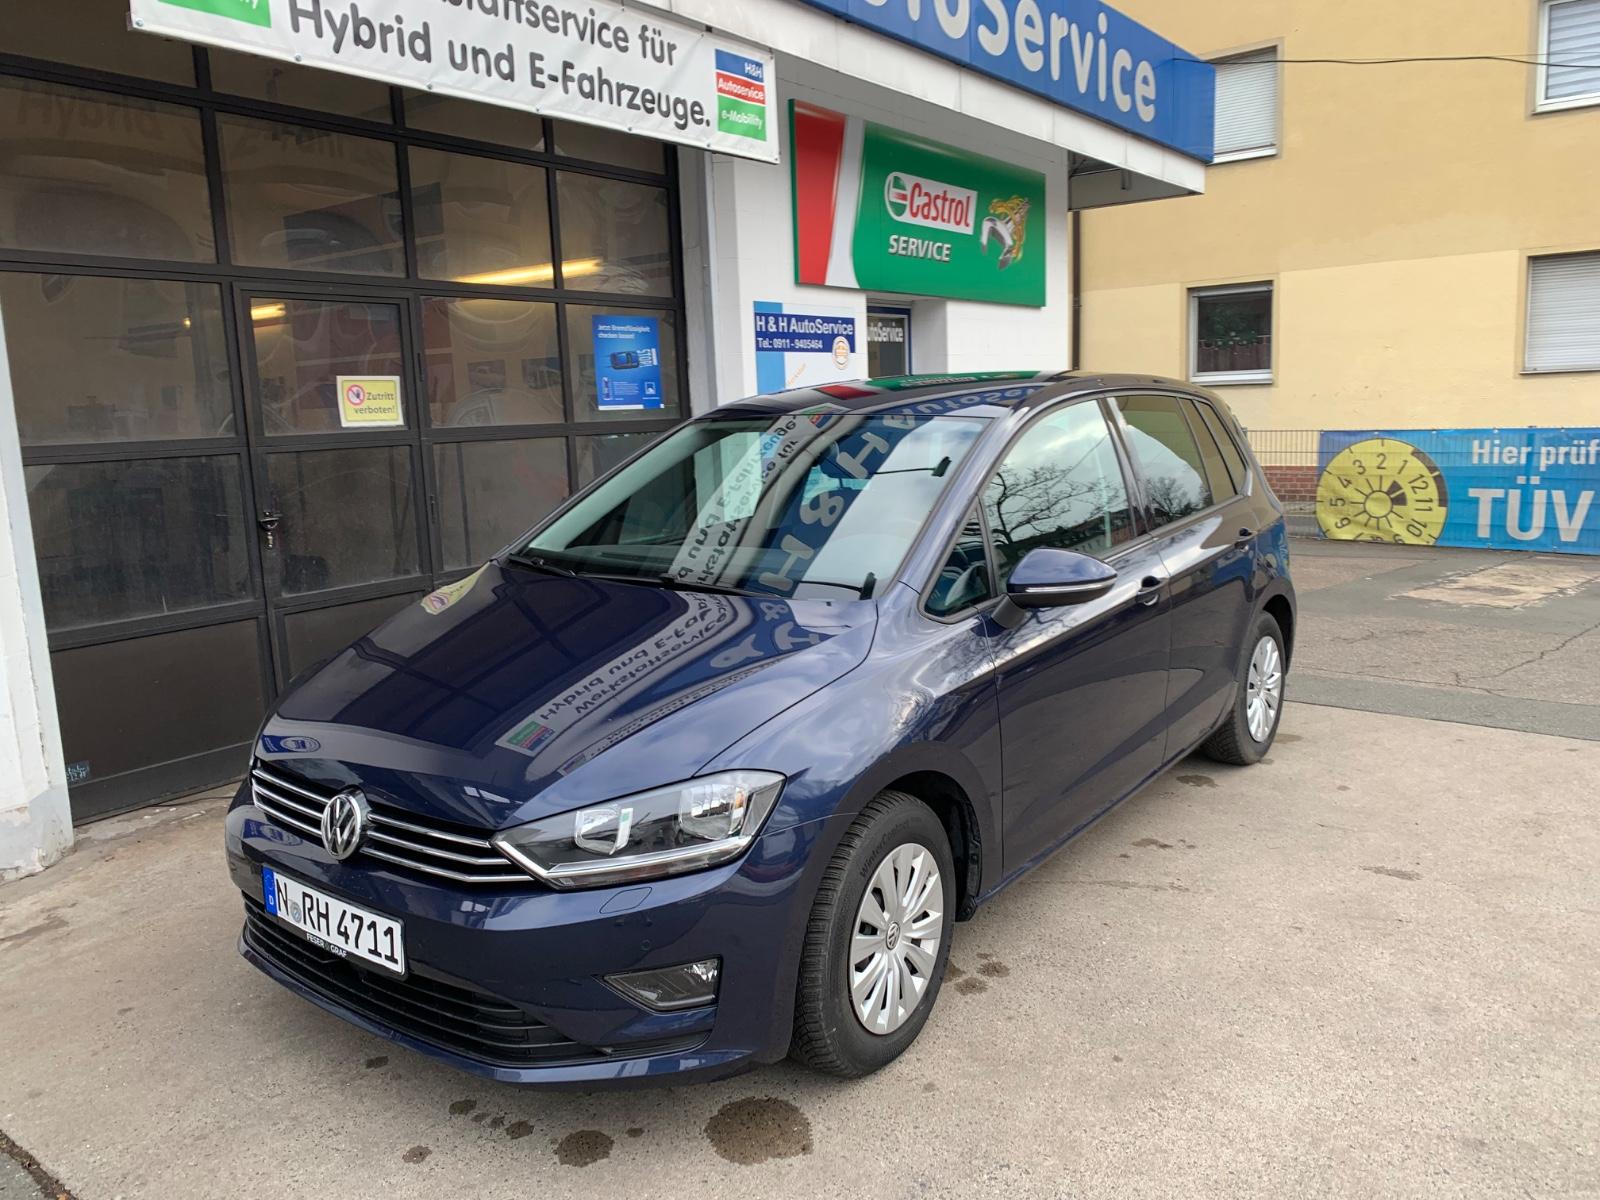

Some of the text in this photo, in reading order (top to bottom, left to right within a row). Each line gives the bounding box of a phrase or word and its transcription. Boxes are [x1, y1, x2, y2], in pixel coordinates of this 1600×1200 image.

[638, 23, 678, 66] für
[289, 0, 711, 131] Hybrid und E-Fahrzeuge.
[718, 78, 764, 101] Autoservice
[909, 182, 971, 228] Castrol
[888, 235, 952, 263] SERVICE
[756, 315, 854, 335] H & H AutoService
[366, 391, 394, 401] Zutritt
[354, 405, 395, 414] verboten!
[1377, 453, 1387, 470] 2
[1471, 439, 1531, 465] Hier
[1352, 459, 1367, 476] 3
[1398, 459, 1408, 475] 1
[1340, 476, 1352, 490] 4
[1408, 473, 1430, 495] 12
[1330, 497, 1346, 507] 5
[1415, 499, 1433, 514] 11
[1468, 476, 1596, 542] TÜV
[1334, 516, 1351, 529] 6
[1406, 518, 1428, 538] 10
[276, 878, 399, 965] N RH 4711
[306, 932, 347, 958] FESER GRAF
